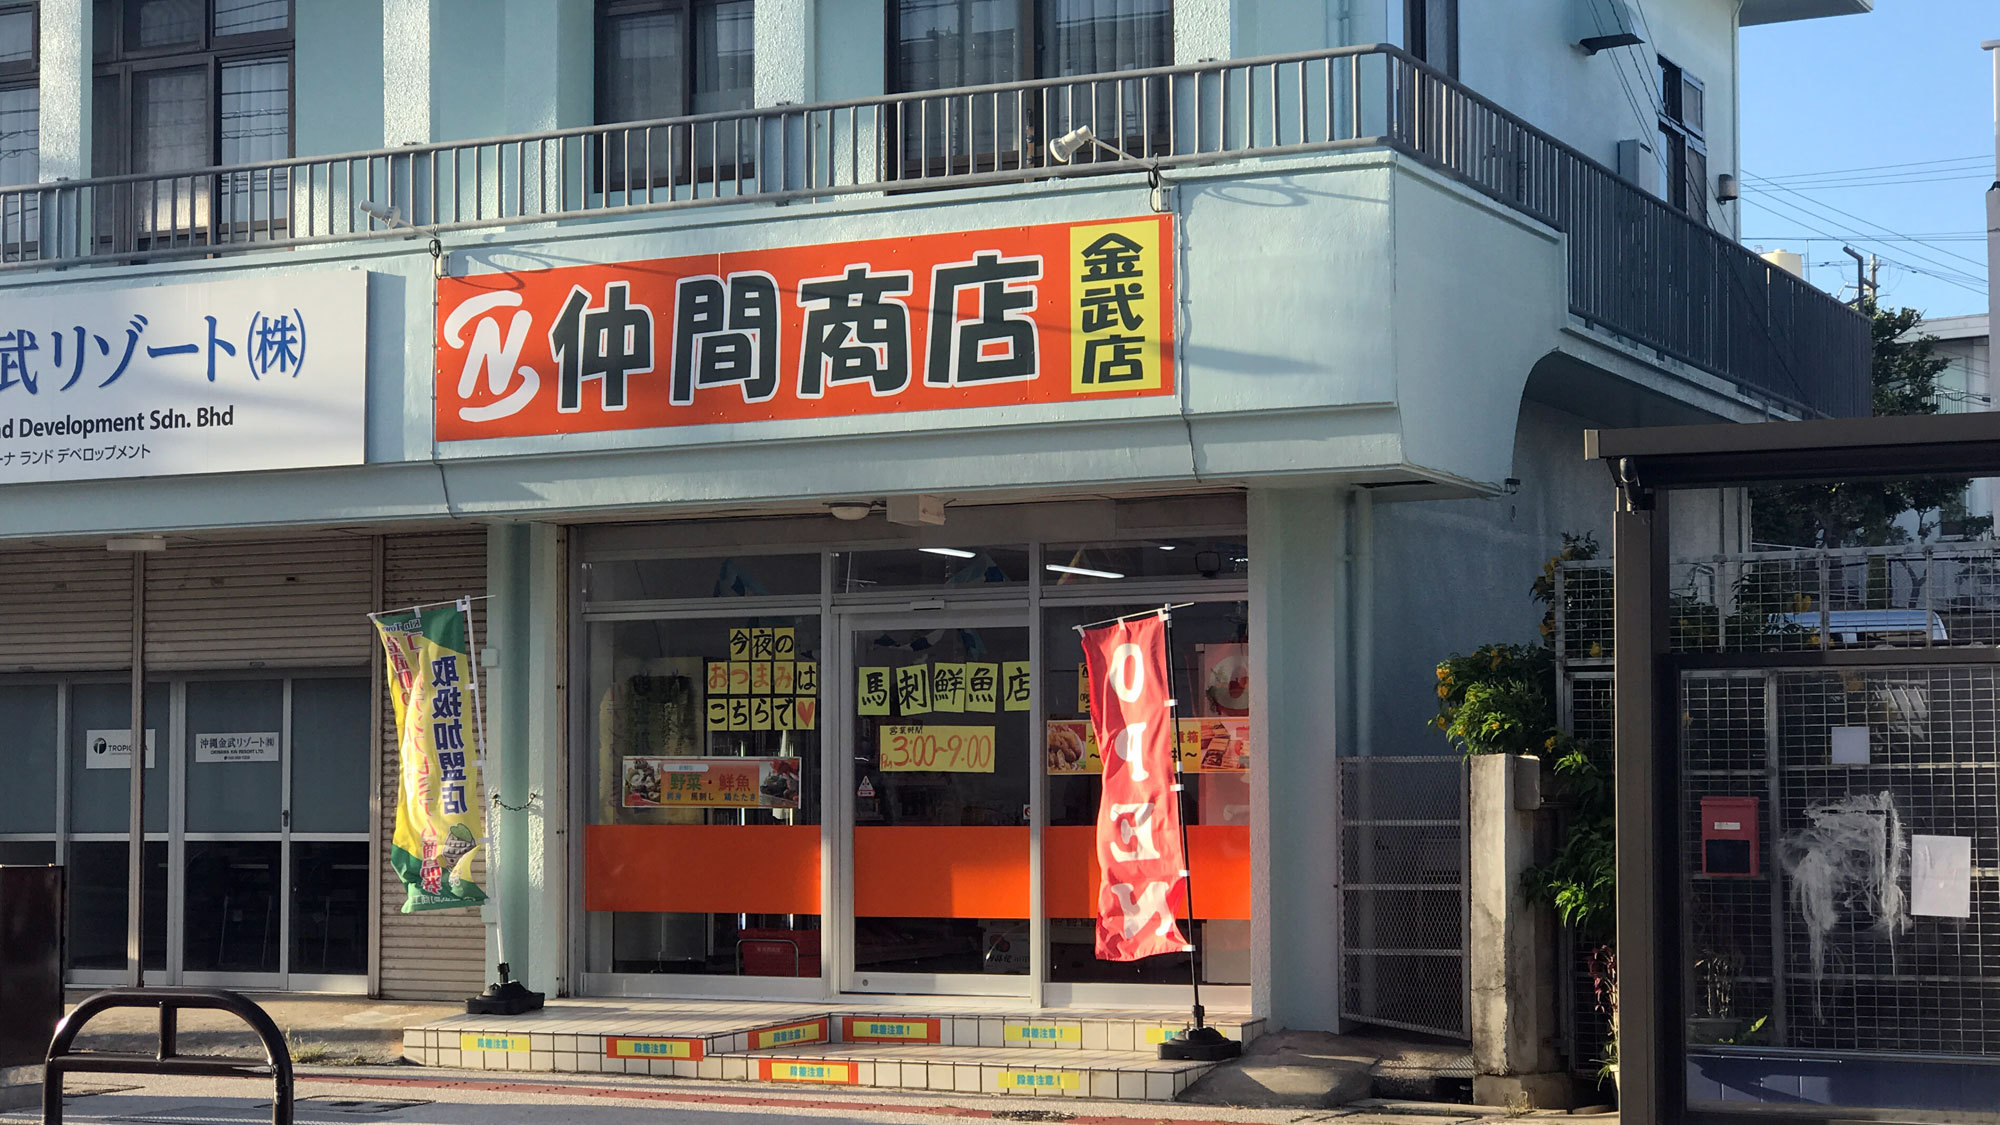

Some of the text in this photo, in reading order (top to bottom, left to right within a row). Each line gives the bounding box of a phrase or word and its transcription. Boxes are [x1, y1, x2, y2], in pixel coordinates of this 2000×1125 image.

[1080, 232, 1145, 384] 金武店
[548, 250, 1044, 412] 仲間商店
[0, 405, 235, 440] d Development Sdn. Bhd
[20, 449, 55, 466] ランド
[57, 443, 151, 465] デベロップメント
[730, 629, 794, 658] 今夜の
[708, 663, 816, 690] おつまみは
[710, 698, 794, 726] こちらで
